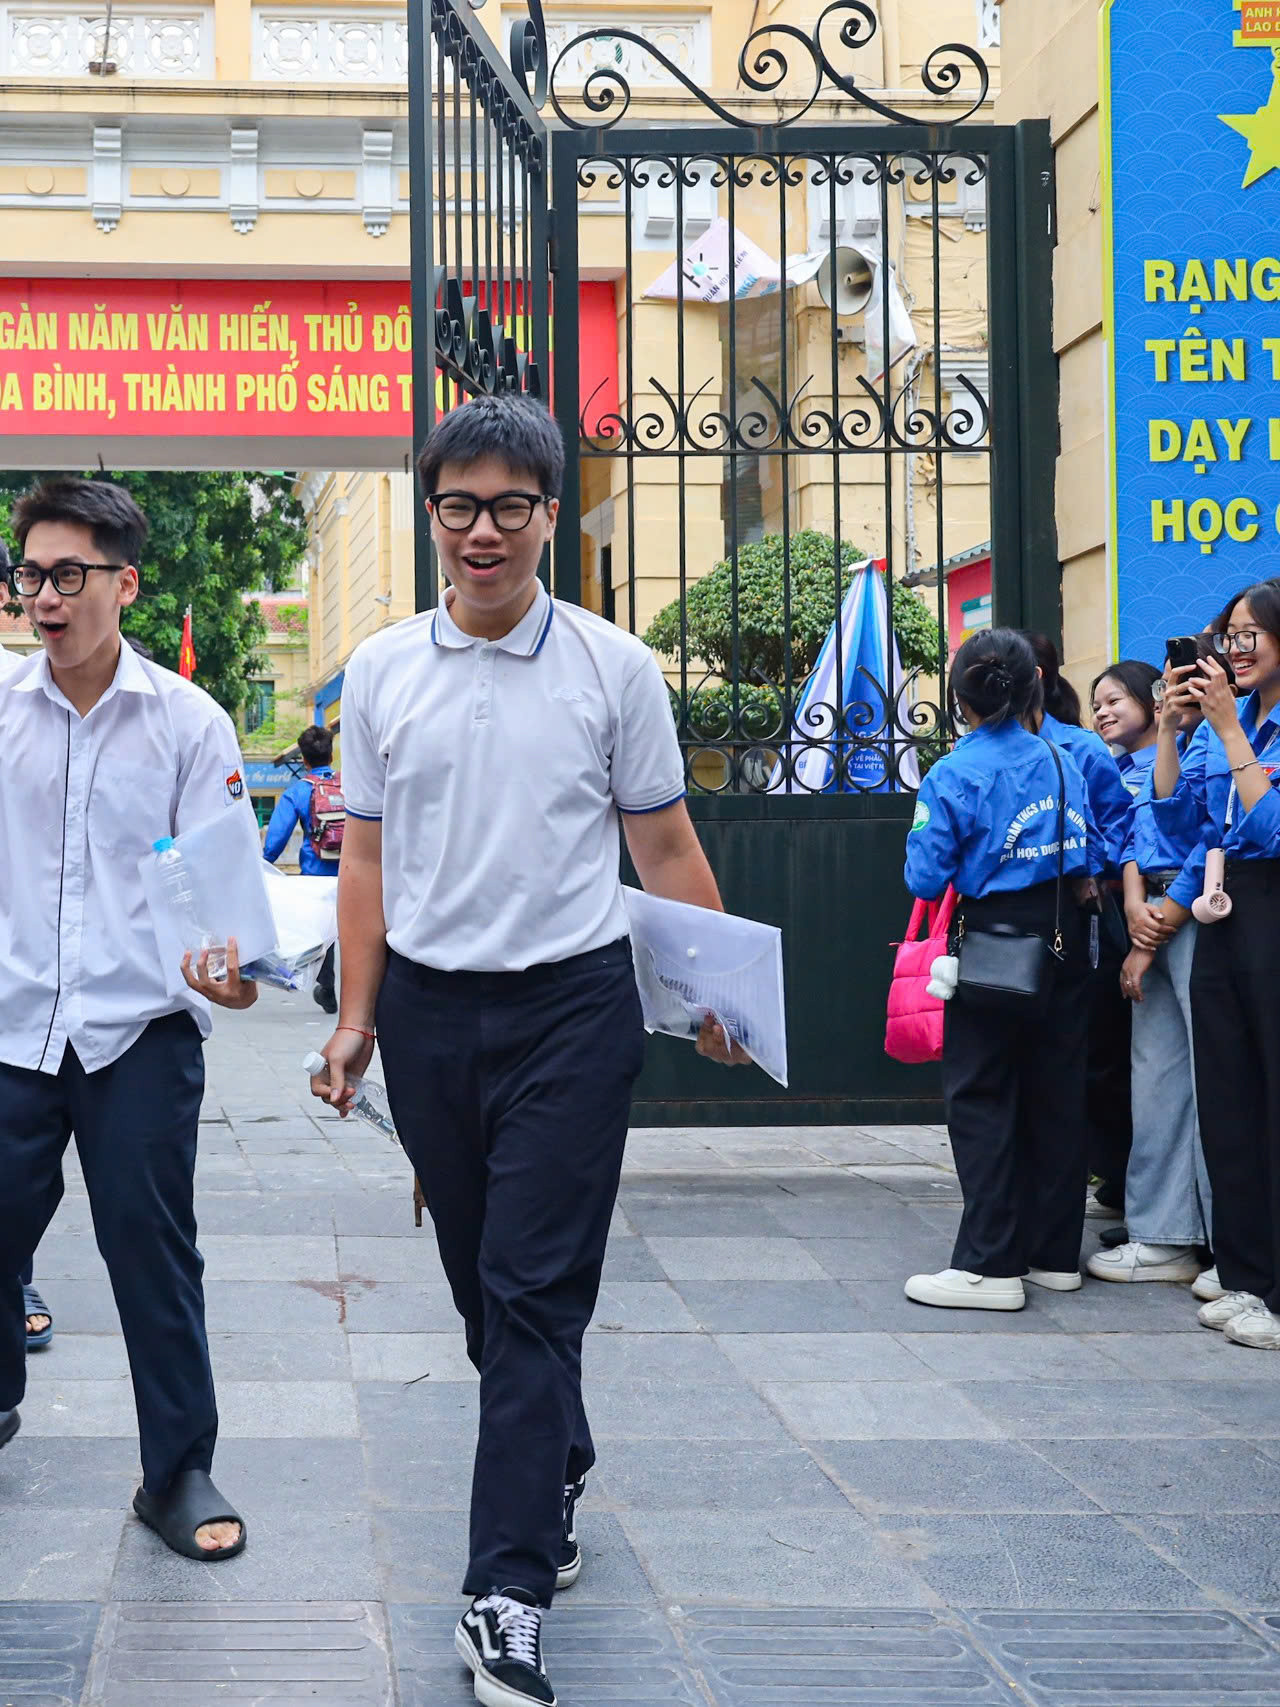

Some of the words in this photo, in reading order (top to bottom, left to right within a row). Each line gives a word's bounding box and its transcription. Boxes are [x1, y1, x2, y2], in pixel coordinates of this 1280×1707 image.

[1246, 7, 1273, 18] ANH
[1246, 21, 1272, 32] LAO
[1144, 257, 1280, 314] RẠNG
[69, 304, 138, 351] NĂM
[147, 304, 209, 351] VĂN
[219, 301, 297, 359] HIẾN,
[304, 302, 364, 352] THỦ
[372, 305, 412, 353] ĐÔ
[1144, 326, 1246, 382] TÊN
[33, 363, 116, 420] BÌNH,
[123, 364, 227, 412] THÀNH
[236, 361, 301, 413] PHỐ
[307, 364, 390, 413] SÁNG
[1148, 418, 1252, 475] DẠY
[1151, 498, 1259, 554] HỌC
[1016, 847, 1039, 861] HỌC
